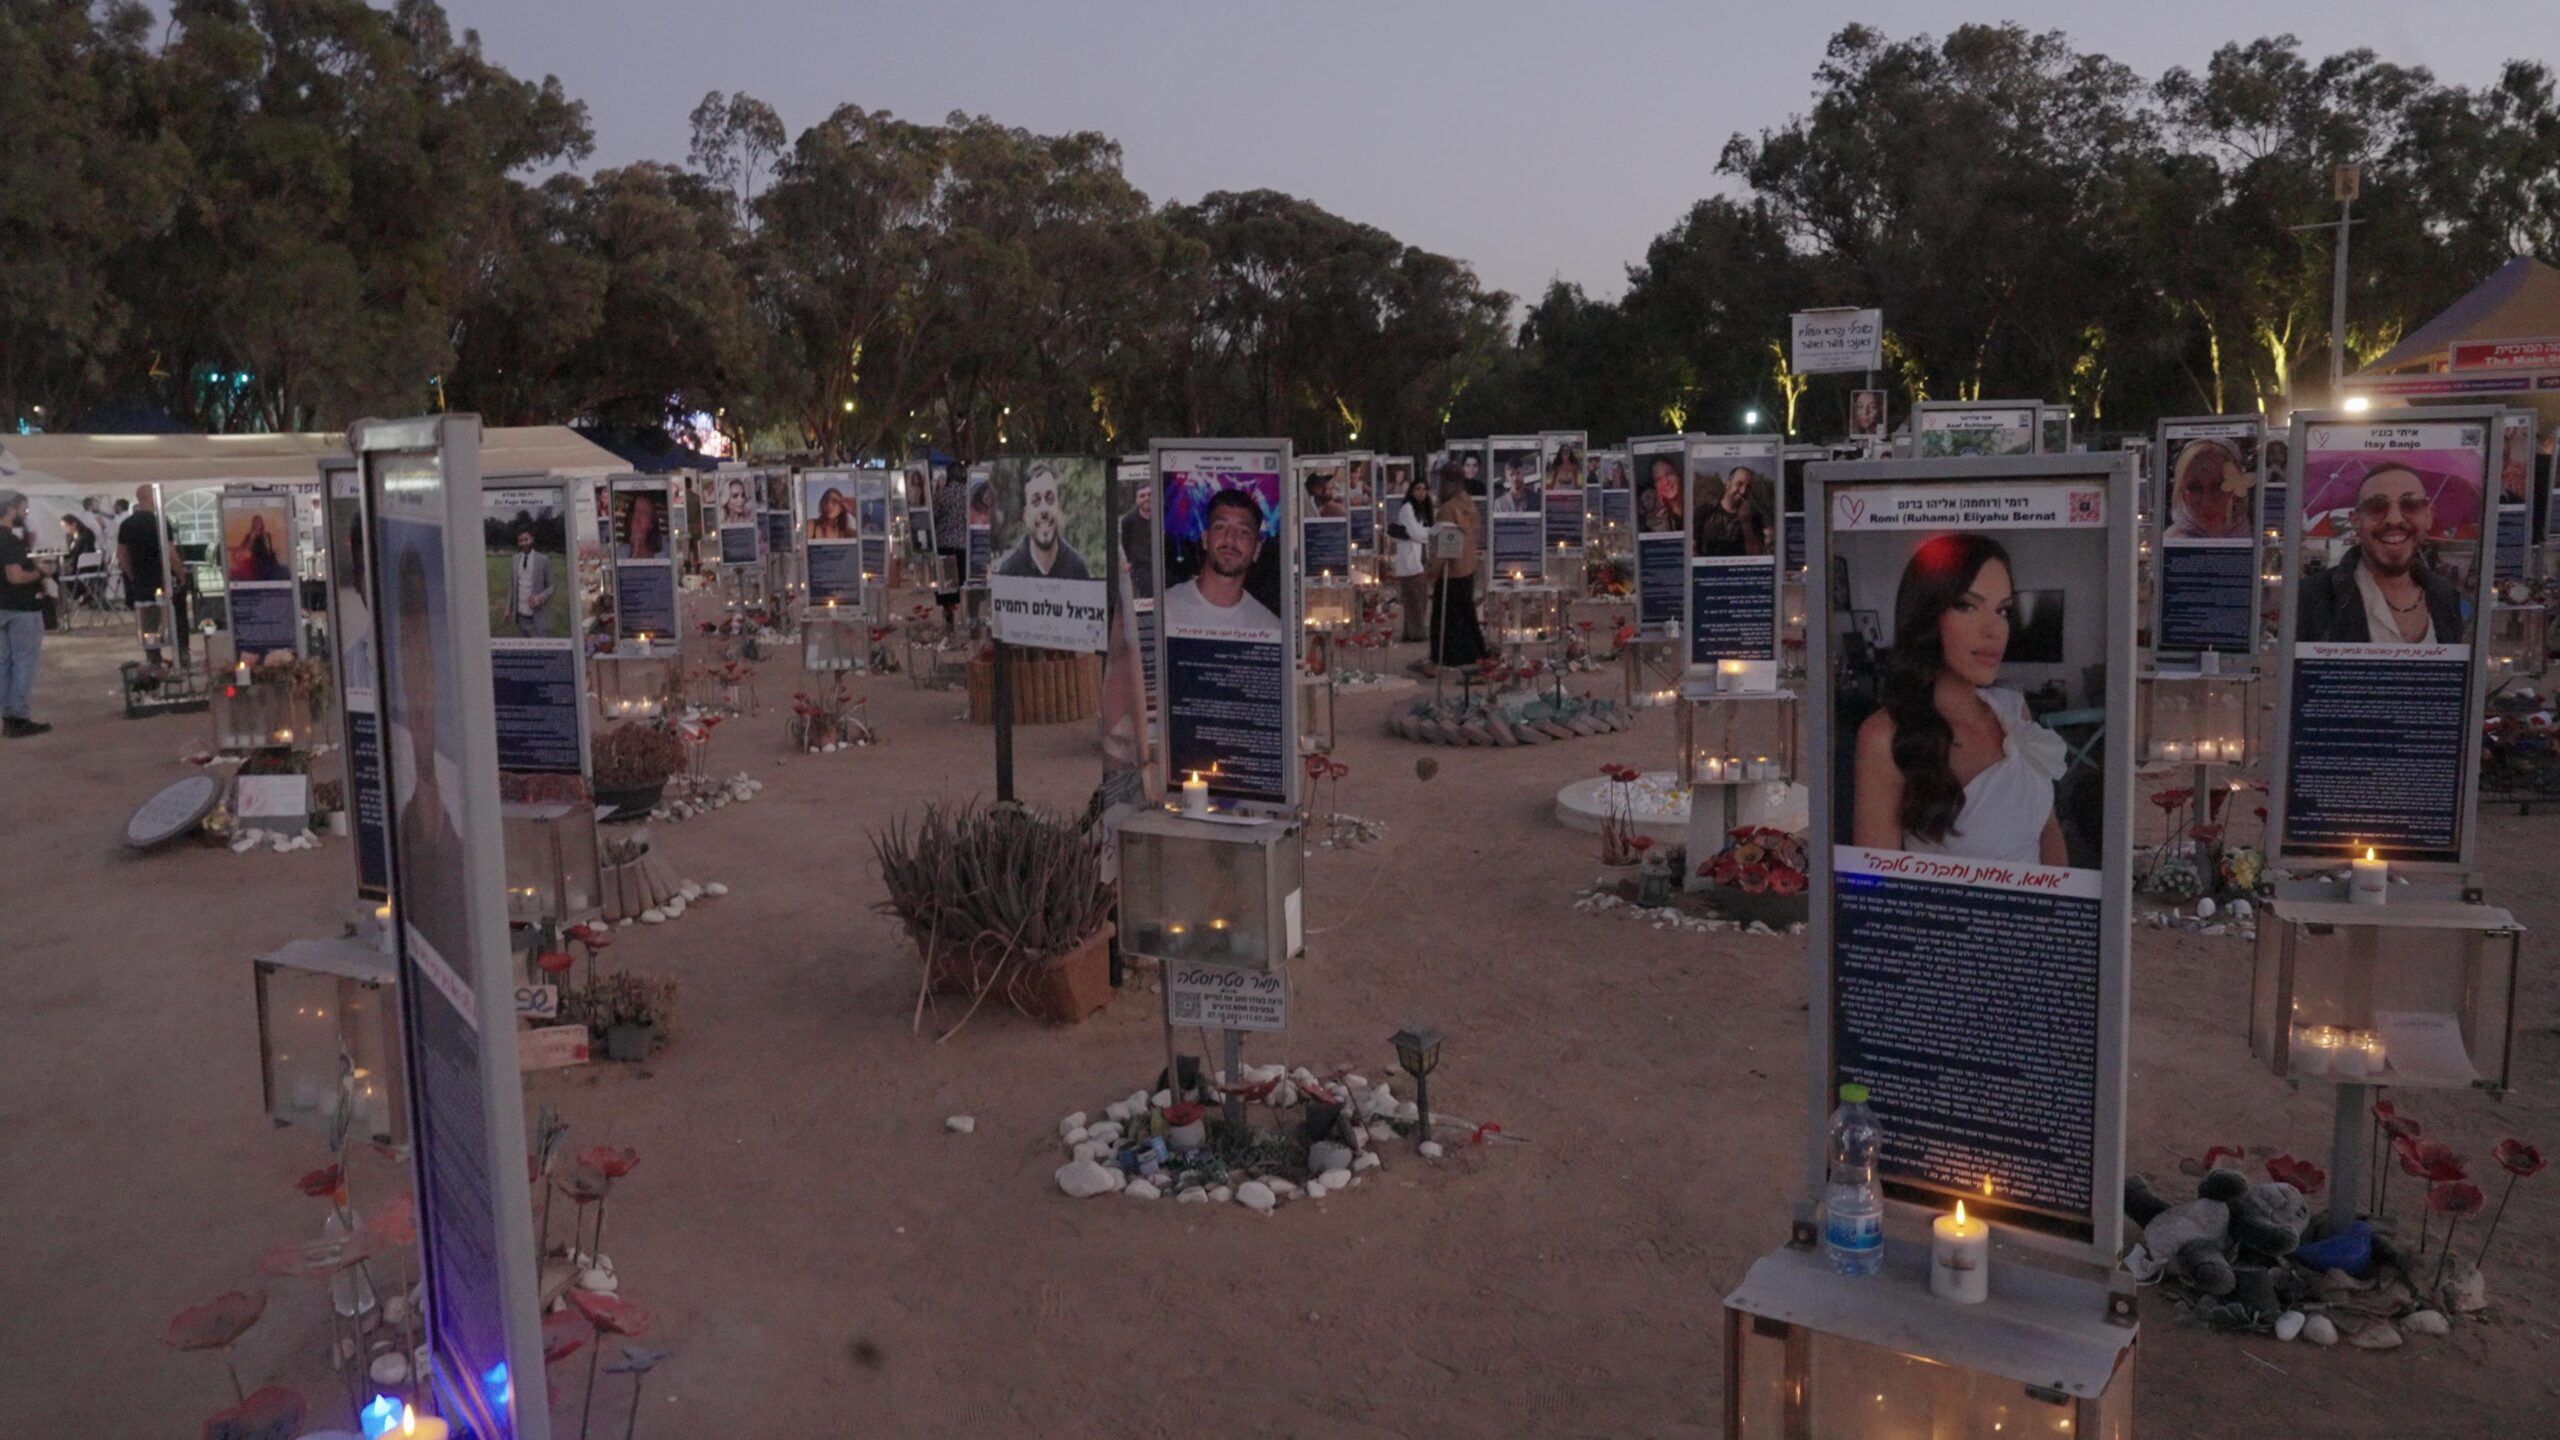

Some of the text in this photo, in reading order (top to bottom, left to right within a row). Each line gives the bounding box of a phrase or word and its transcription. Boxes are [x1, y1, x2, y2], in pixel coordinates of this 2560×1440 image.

[2396, 428, 2419, 437] איתי
[2364, 439, 2421, 450] Itay Banjo
[1897, 497, 2028, 510] רומי (רוחמה) אליהו ברנט
[1870, 511, 2056, 525] Romi (Ruhama) Eliyahu Bernat
[994, 598, 1105, 622] אביאל שלום רחמים
[1863, 852, 1914, 872] טובה"
[1914, 859, 1968, 878] וחברה
[1968, 867, 2012, 883] אחות
[1176, 969, 1280, 993] תומר סטרוסטה
